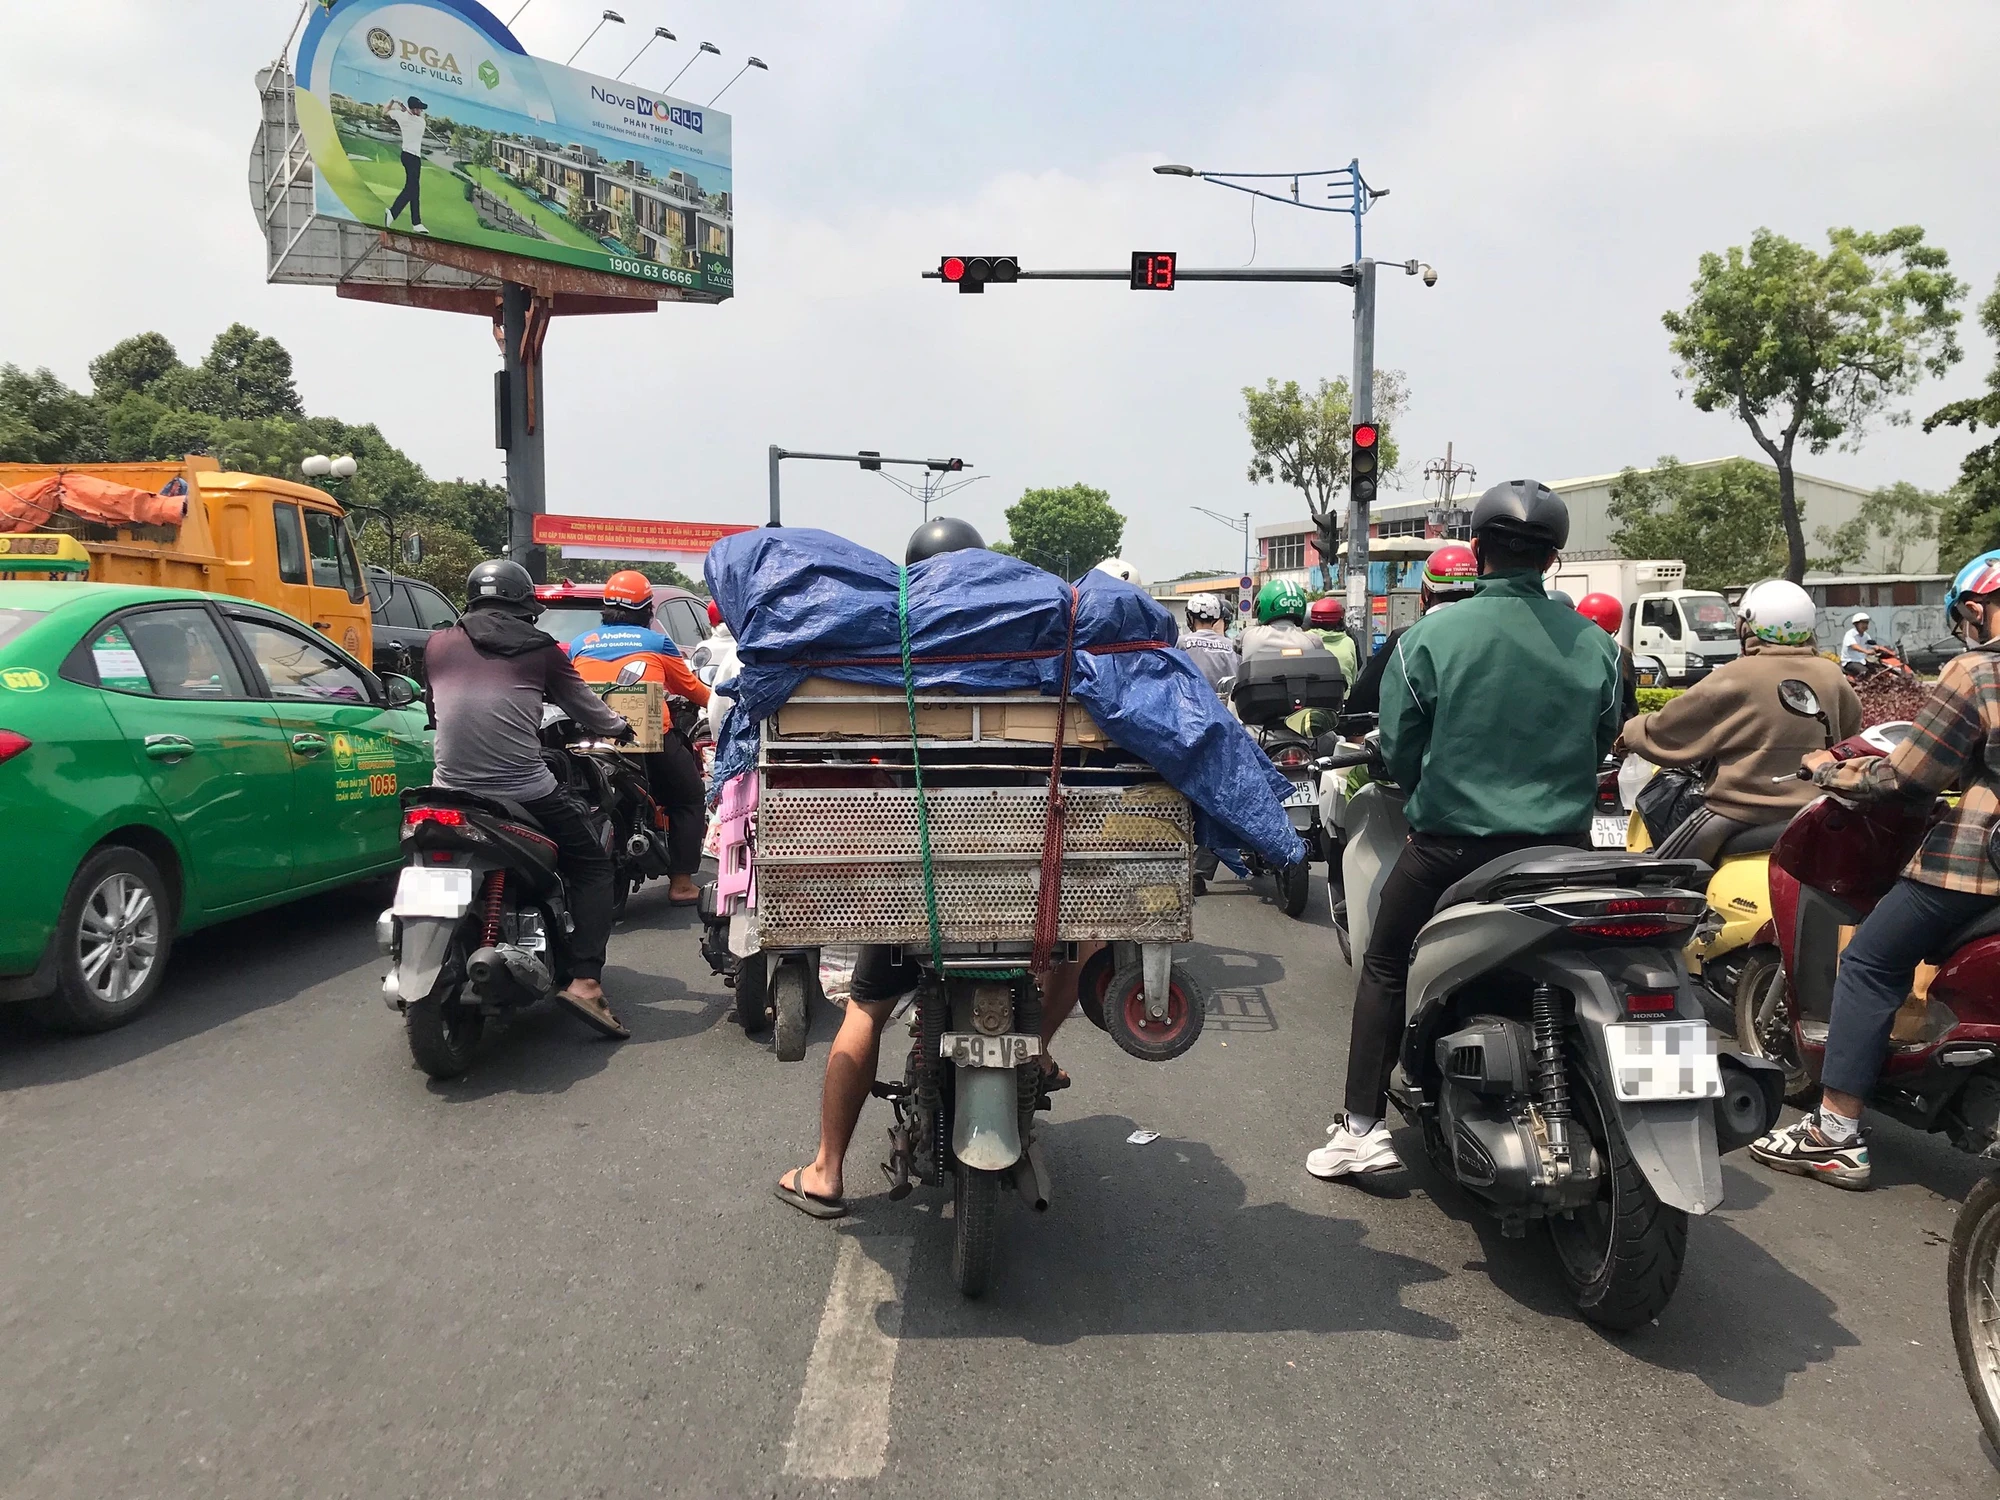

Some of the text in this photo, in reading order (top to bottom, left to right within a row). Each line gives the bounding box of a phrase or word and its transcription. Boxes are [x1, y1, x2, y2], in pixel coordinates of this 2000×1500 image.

[399, 38, 462, 75] PGA
[400, 61, 463, 86] GOLF VILLAS
[606, 124, 625, 134] THÀNH
[623, 117, 674, 136] PHAN THIET
[609, 258, 640, 274] 1900
[643, 264, 659, 279] 63
[661, 268, 693, 285] 6666
[1147, 255, 1173, 288] 13
[707, 275, 733, 286] LAND
[10, 538, 59, 554] 1055
[1279, 597, 1303, 608] Grab
[601, 632, 641, 640] AhaMove
[336, 777, 349, 788] TỔNG
[369, 773, 397, 797] 1055
[335, 787, 363, 801] TOÀN QUỐC
